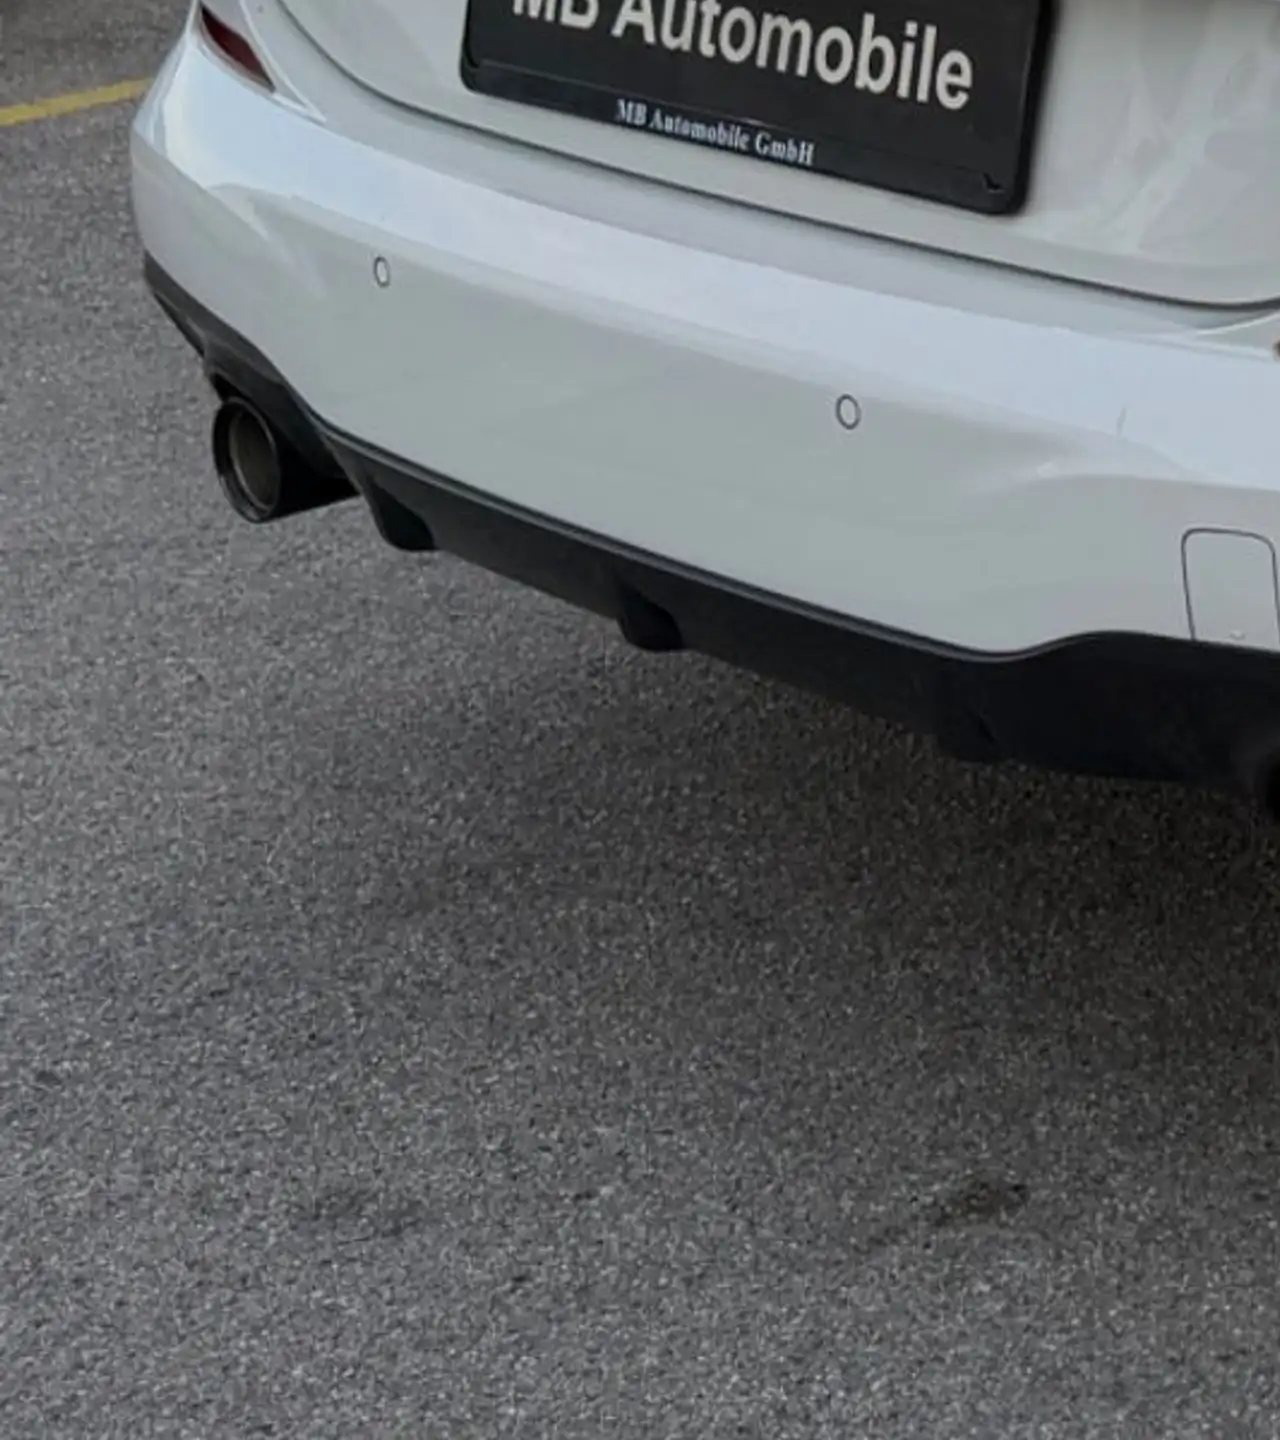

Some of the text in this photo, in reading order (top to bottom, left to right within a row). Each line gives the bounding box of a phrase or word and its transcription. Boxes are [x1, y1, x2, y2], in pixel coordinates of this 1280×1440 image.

[615, 98, 815, 166] MB Automobile GmbH
